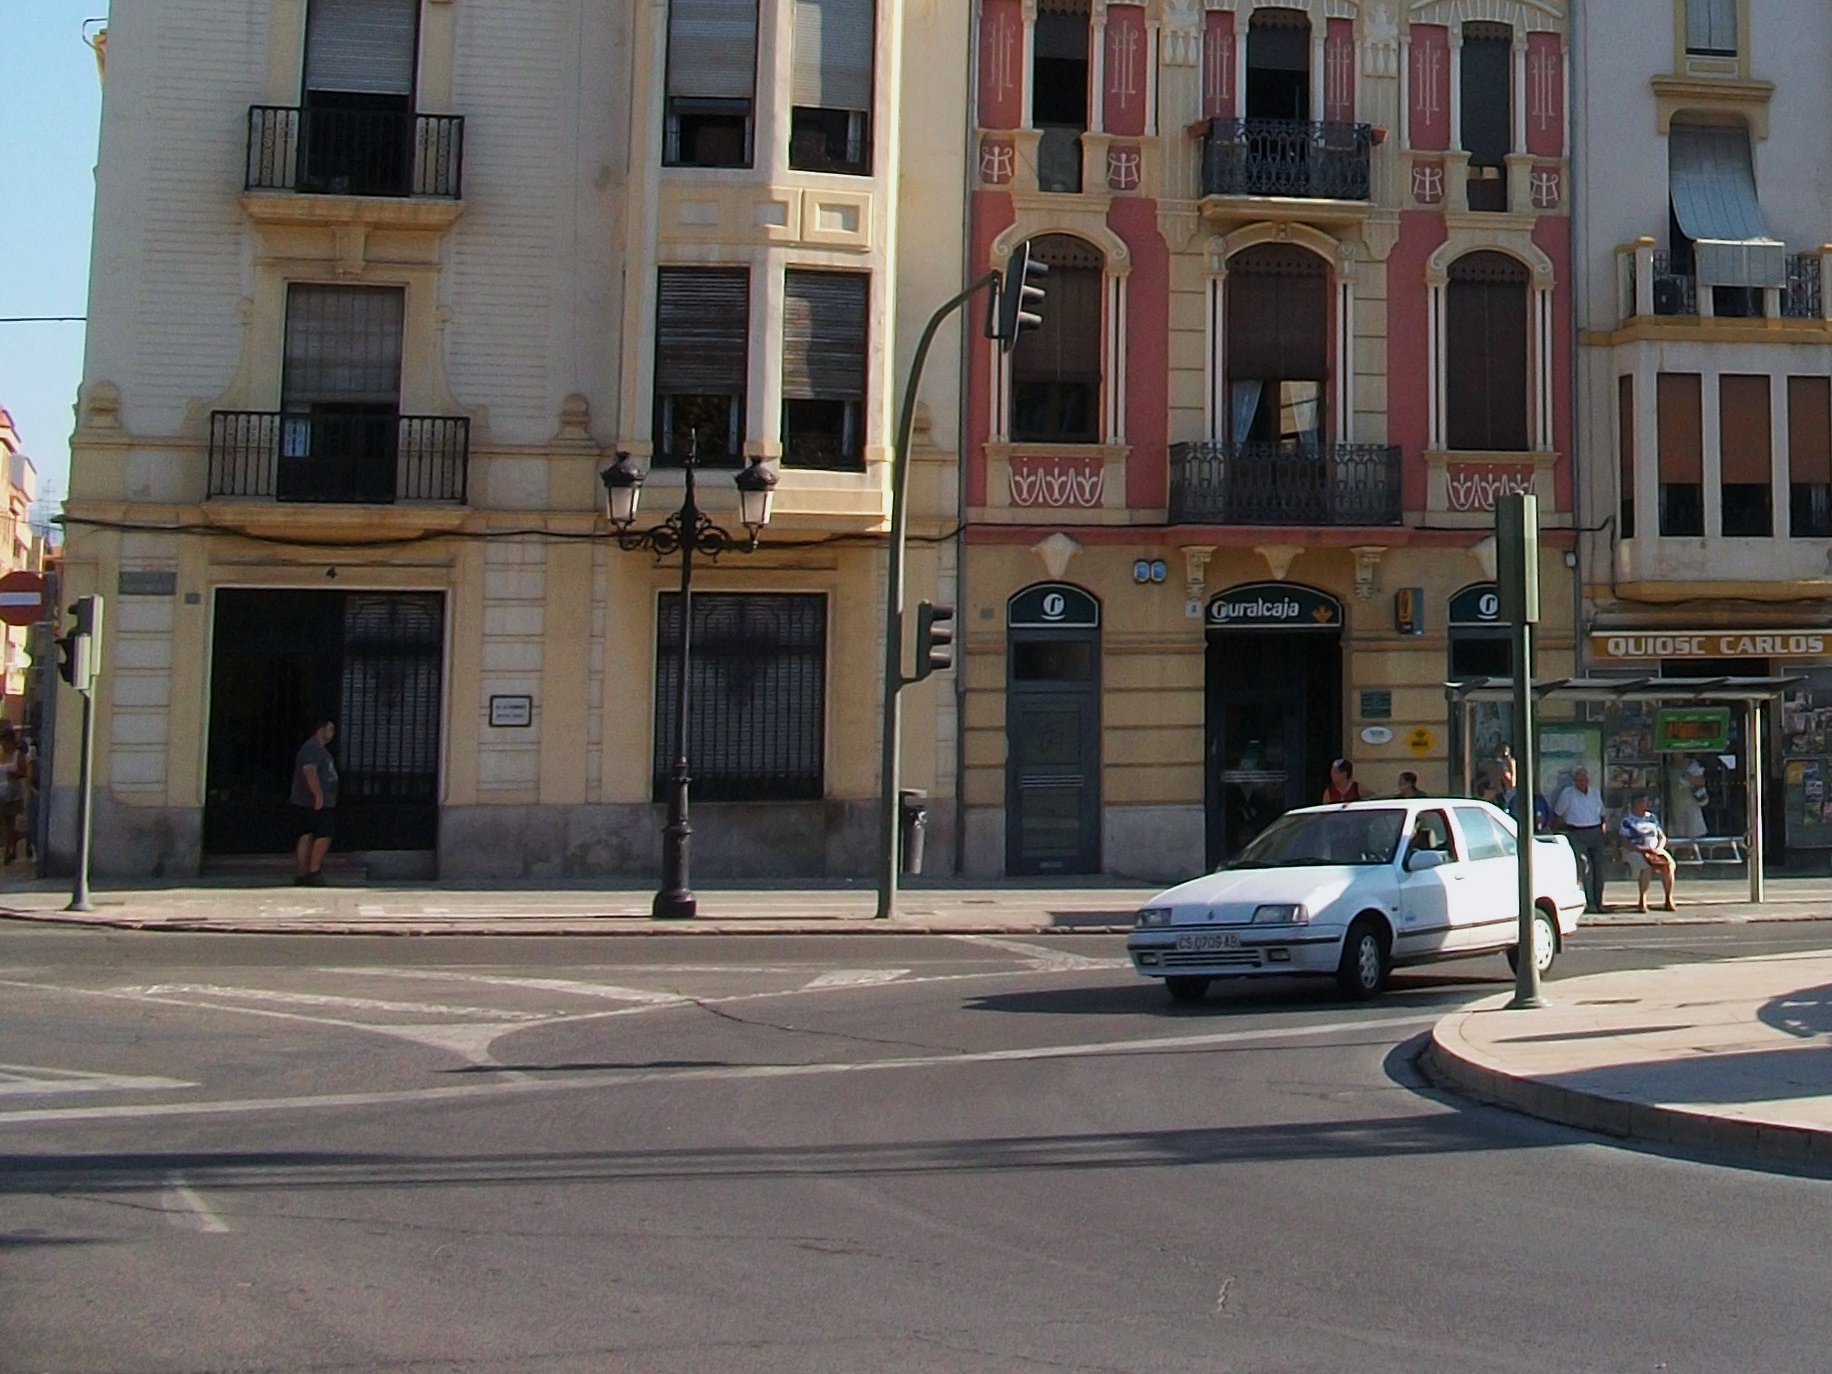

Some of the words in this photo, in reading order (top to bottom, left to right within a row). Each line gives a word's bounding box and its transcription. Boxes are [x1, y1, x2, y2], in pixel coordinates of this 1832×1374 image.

[1210, 597, 1299, 622] ruralcaja
[1607, 637, 1706, 657] QUIOSC
[1719, 636, 1824, 654] CARLOS
